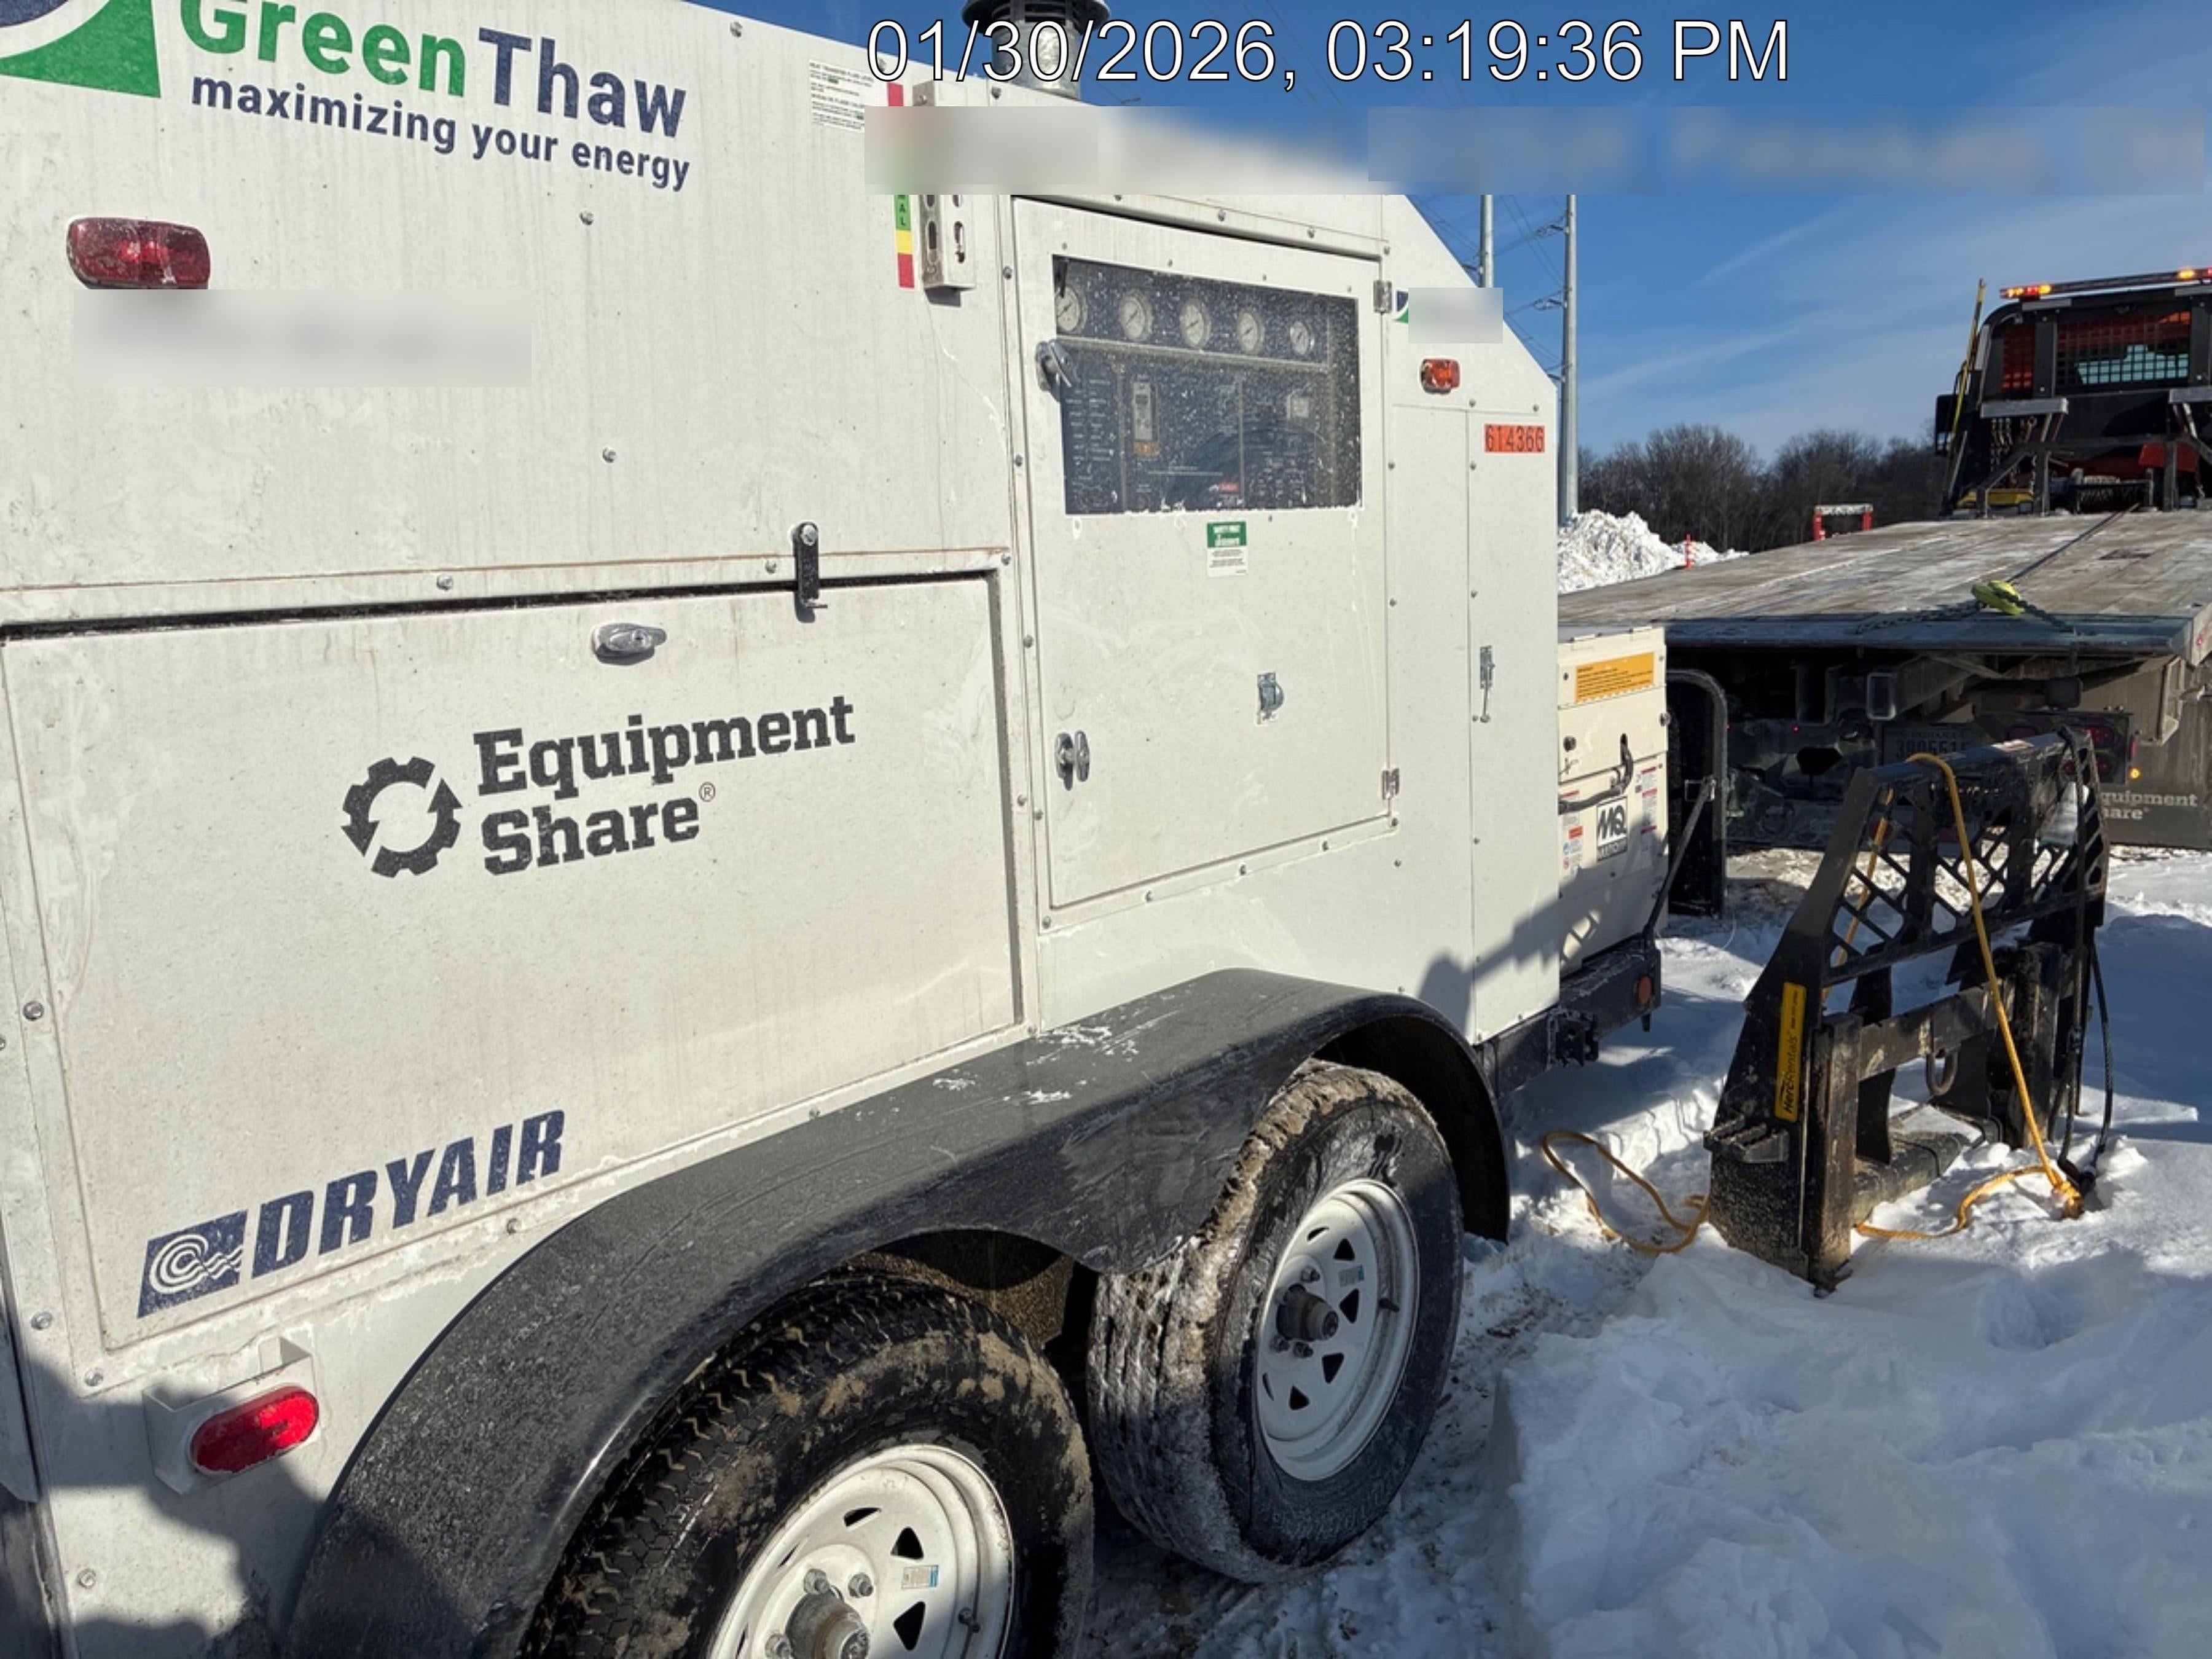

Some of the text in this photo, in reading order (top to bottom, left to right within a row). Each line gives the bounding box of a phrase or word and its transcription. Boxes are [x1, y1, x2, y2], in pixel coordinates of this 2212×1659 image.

[192, 76, 689, 192] maximizing your energy
[473, 696, 855, 800] Equipment
[2101, 790, 2198, 807] quipment
[252, 1110, 565, 1279] DRYAIR
